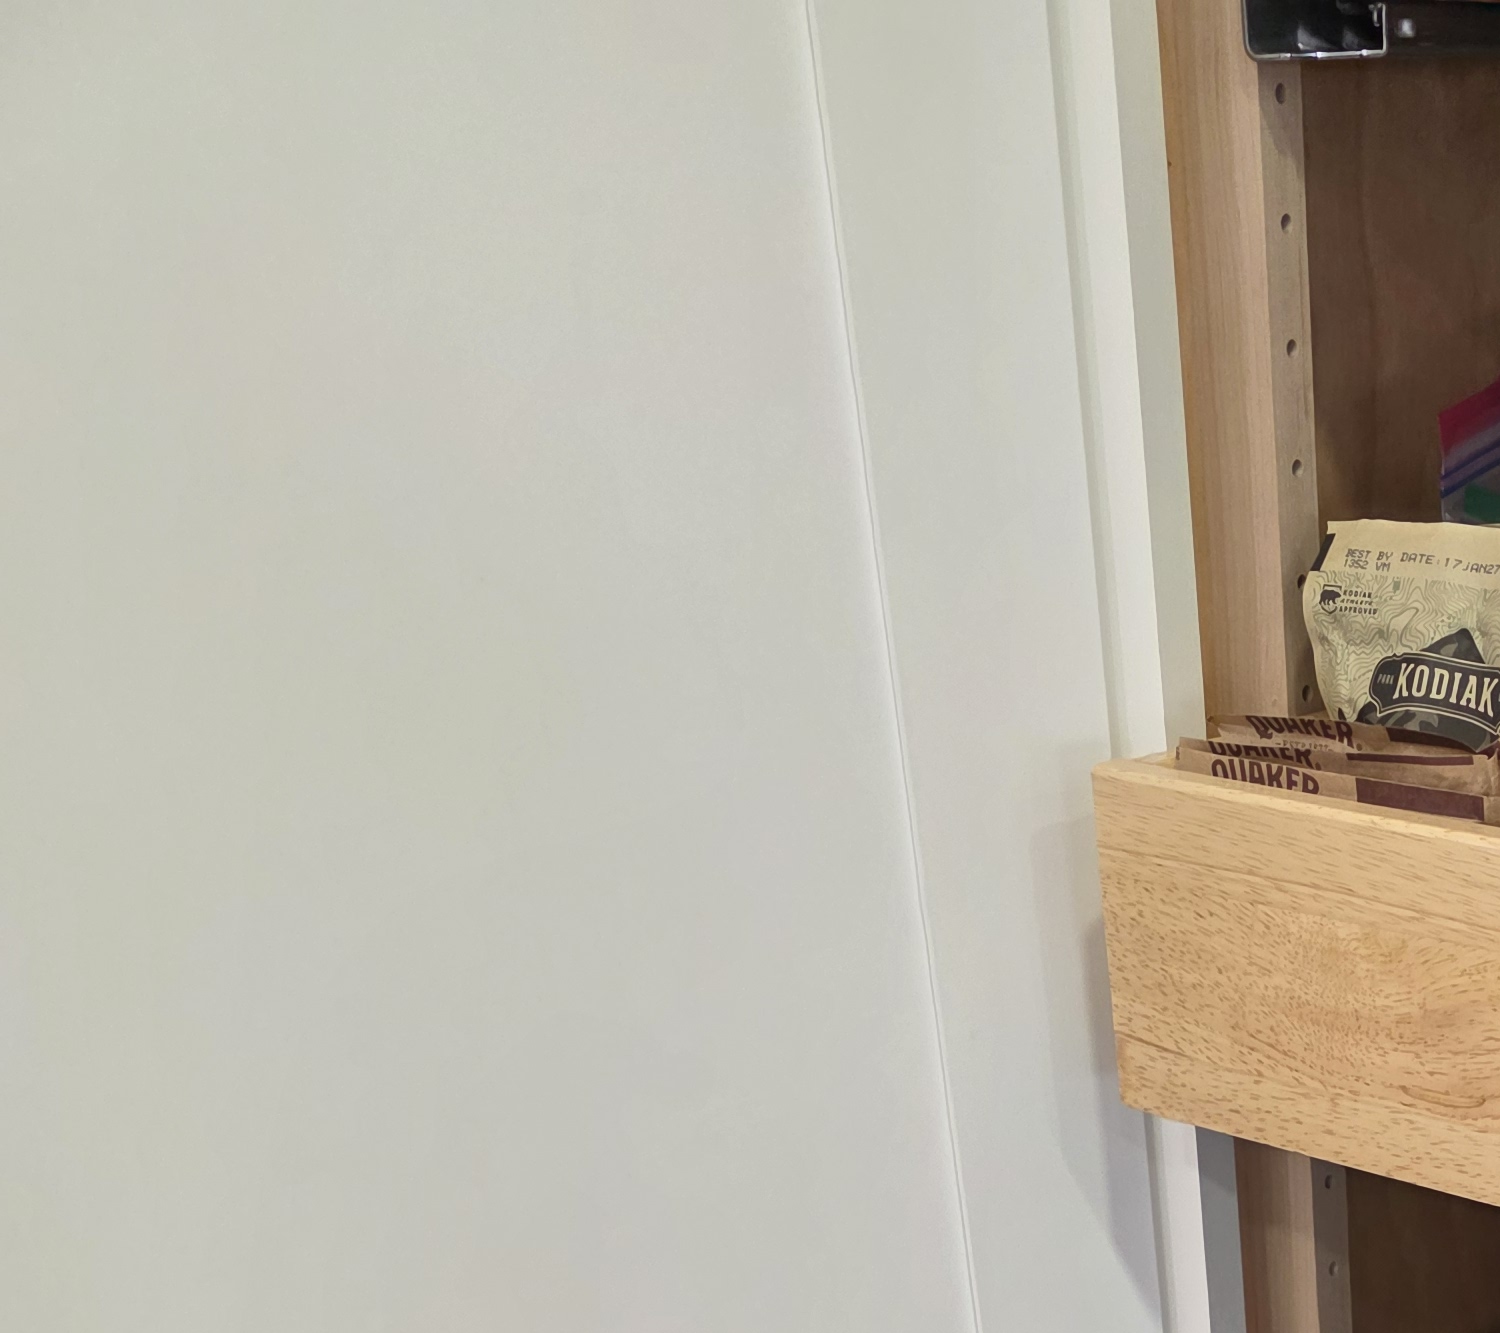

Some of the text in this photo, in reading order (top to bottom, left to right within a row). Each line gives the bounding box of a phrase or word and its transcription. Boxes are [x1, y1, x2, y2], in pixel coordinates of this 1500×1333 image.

[1345, 548, 1394, 562] BEST BY
[1343, 559, 1369, 570] 1352
[1343, 588, 1373, 599] KODIAK
[1338, 606, 1378, 616] APPROVED
[1393, 661, 1499, 717] KODIAK
